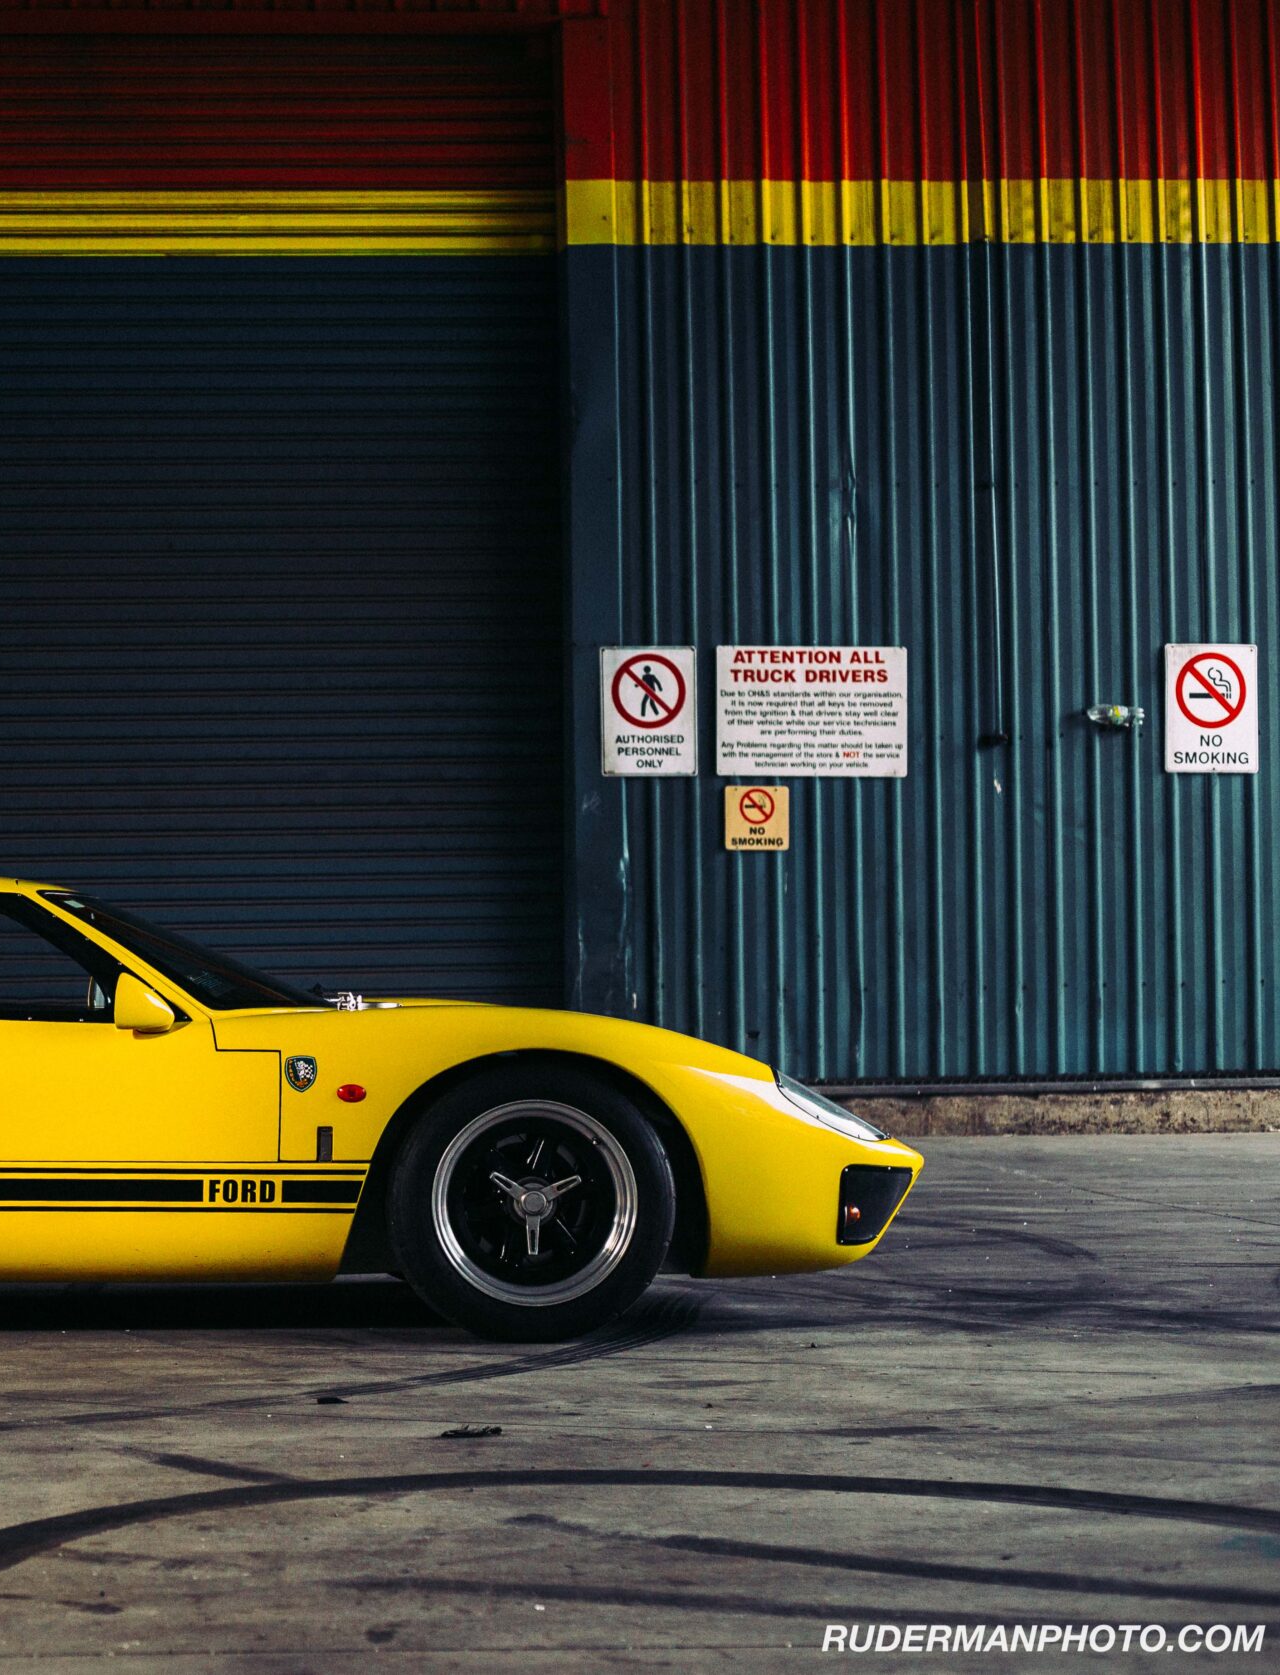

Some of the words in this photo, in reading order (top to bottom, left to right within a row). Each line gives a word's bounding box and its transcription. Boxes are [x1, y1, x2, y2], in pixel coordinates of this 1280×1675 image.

[734, 650, 841, 664] ATTENTION
[850, 651, 885, 664] ALL
[730, 670, 796, 682] TRUCK
[805, 670, 888, 682] DRIVERS
[719, 689, 735, 697] Due
[765, 700, 797, 708] required
[827, 700, 845, 708] keys
[759, 709, 788, 718] ignition
[844, 710, 861, 718] stay
[774, 728, 817, 737] performing
[616, 735, 684, 744] AUTHORISED
[1200, 735, 1223, 747] NO
[720, 741, 734, 750] Any
[769, 741, 801, 750] regarding
[617, 747, 681, 756] PERSONNEL
[1174, 752, 1249, 764] SMOKING
[636, 760, 663, 768] ONLY
[790, 761, 816, 769] working
[731, 838, 784, 846] SMOKING
[208, 1179, 276, 1203] FORD
